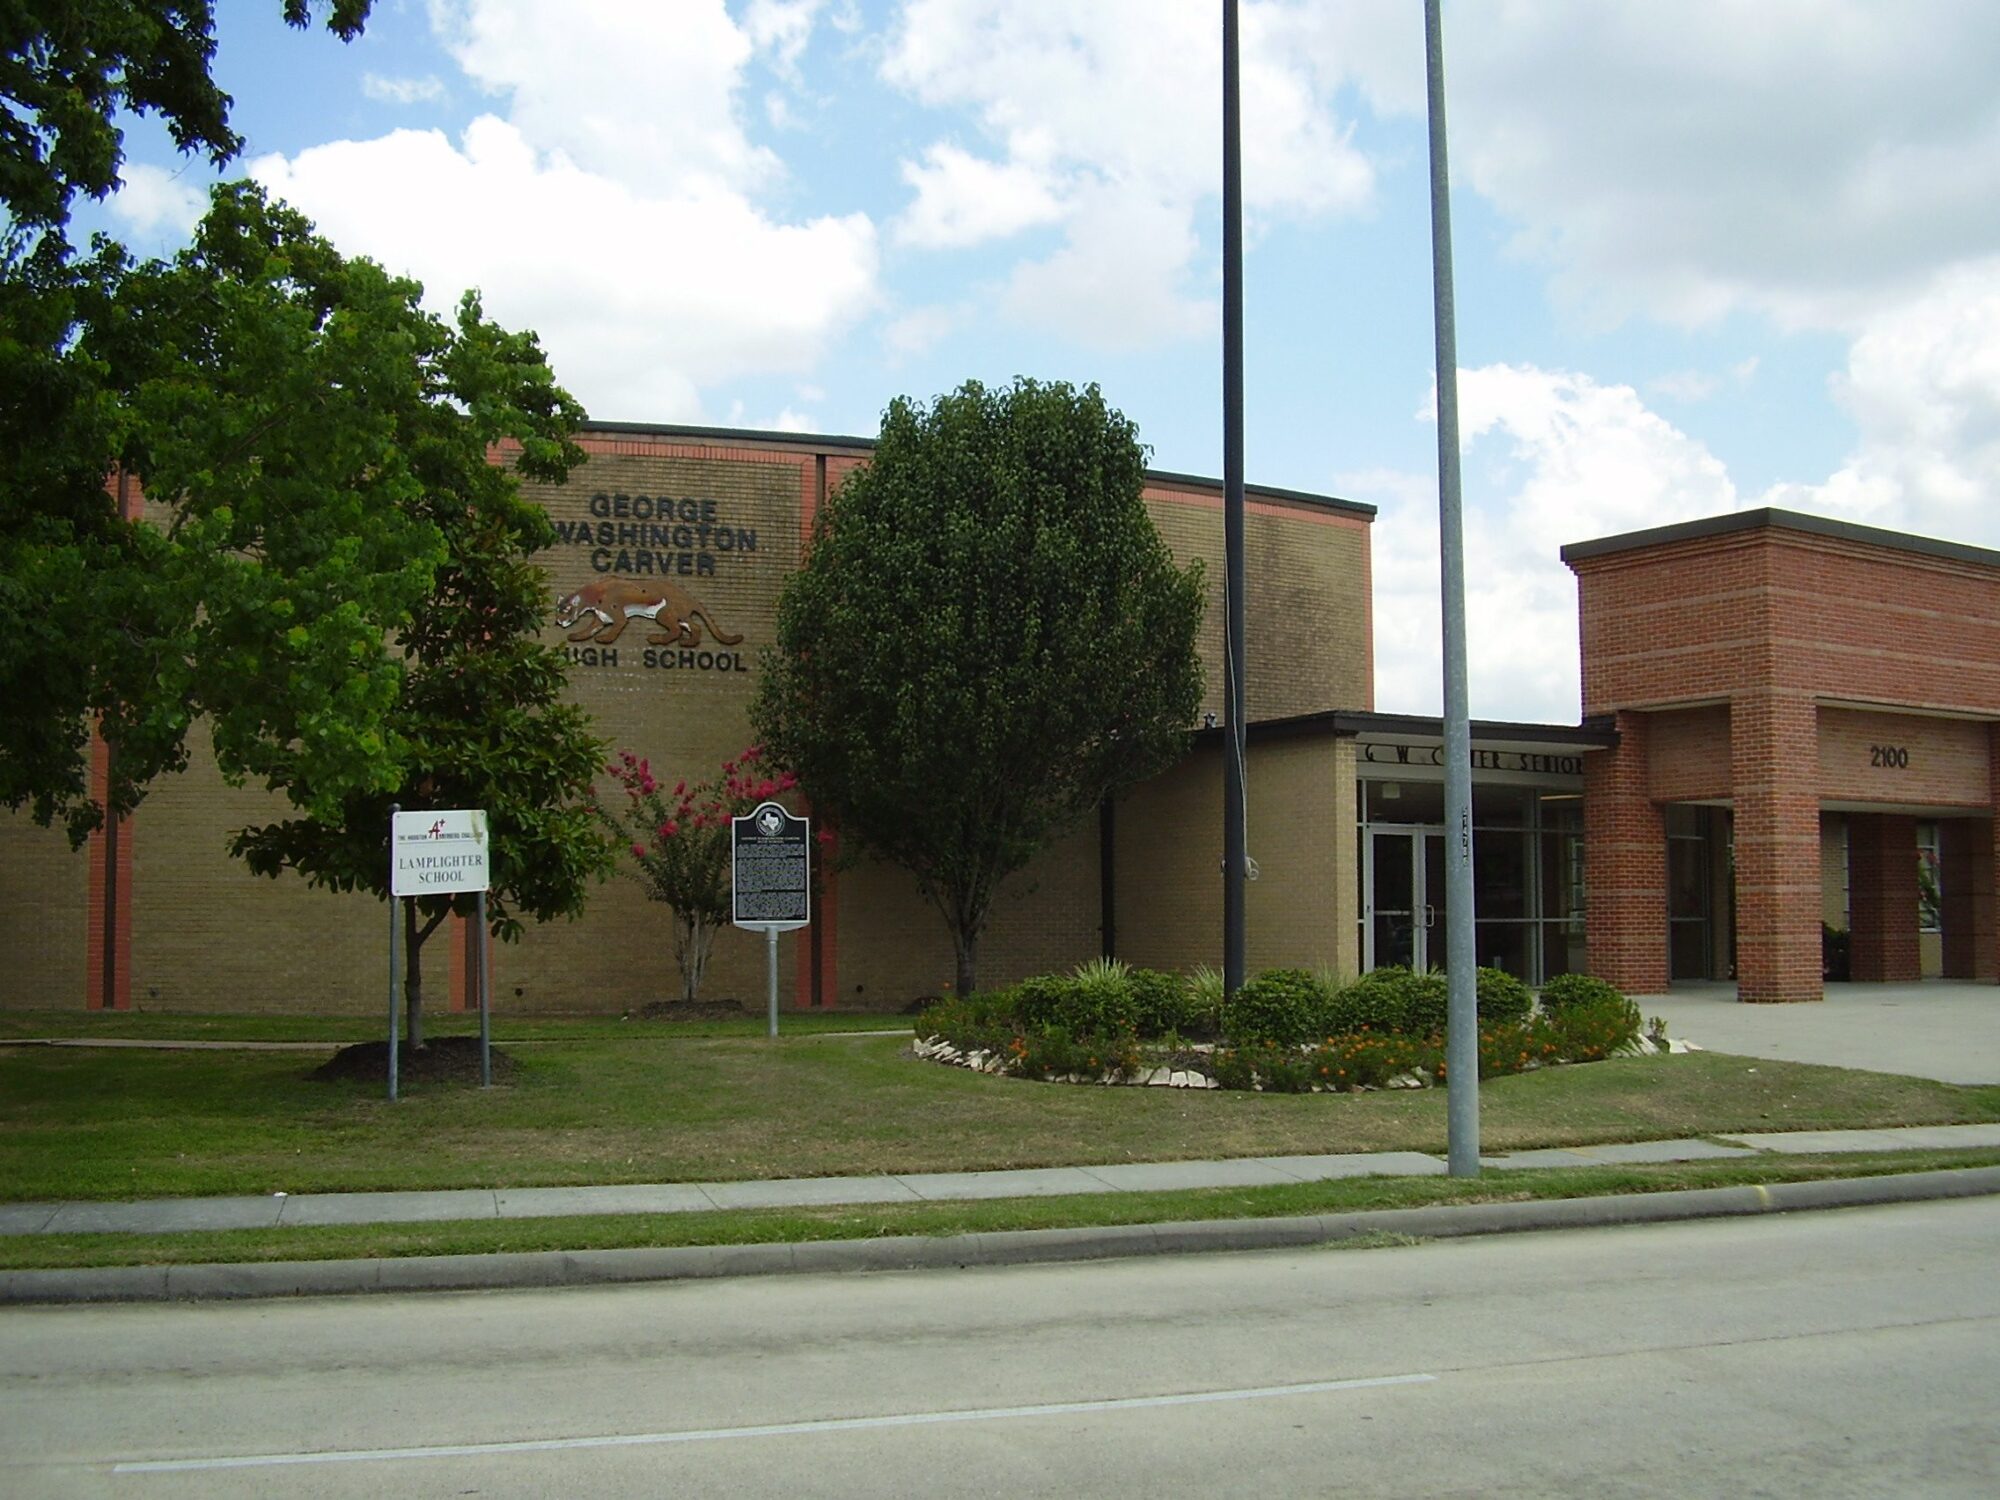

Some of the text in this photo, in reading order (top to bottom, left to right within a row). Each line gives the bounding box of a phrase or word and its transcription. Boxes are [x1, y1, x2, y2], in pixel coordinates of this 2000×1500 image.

[590, 494, 717, 522] GEORGE
[556, 521, 757, 551] WASHINGTON
[591, 548, 716, 576] CARVER
[643, 650, 747, 672] SCHOOL
[1365, 743, 1374, 762] G
[1397, 745, 1408, 764] W
[1871, 745, 1908, 768] 2100
[400, 855, 482, 869] LAMPLIGHTER
[419, 871, 464, 883] SCHOOL
